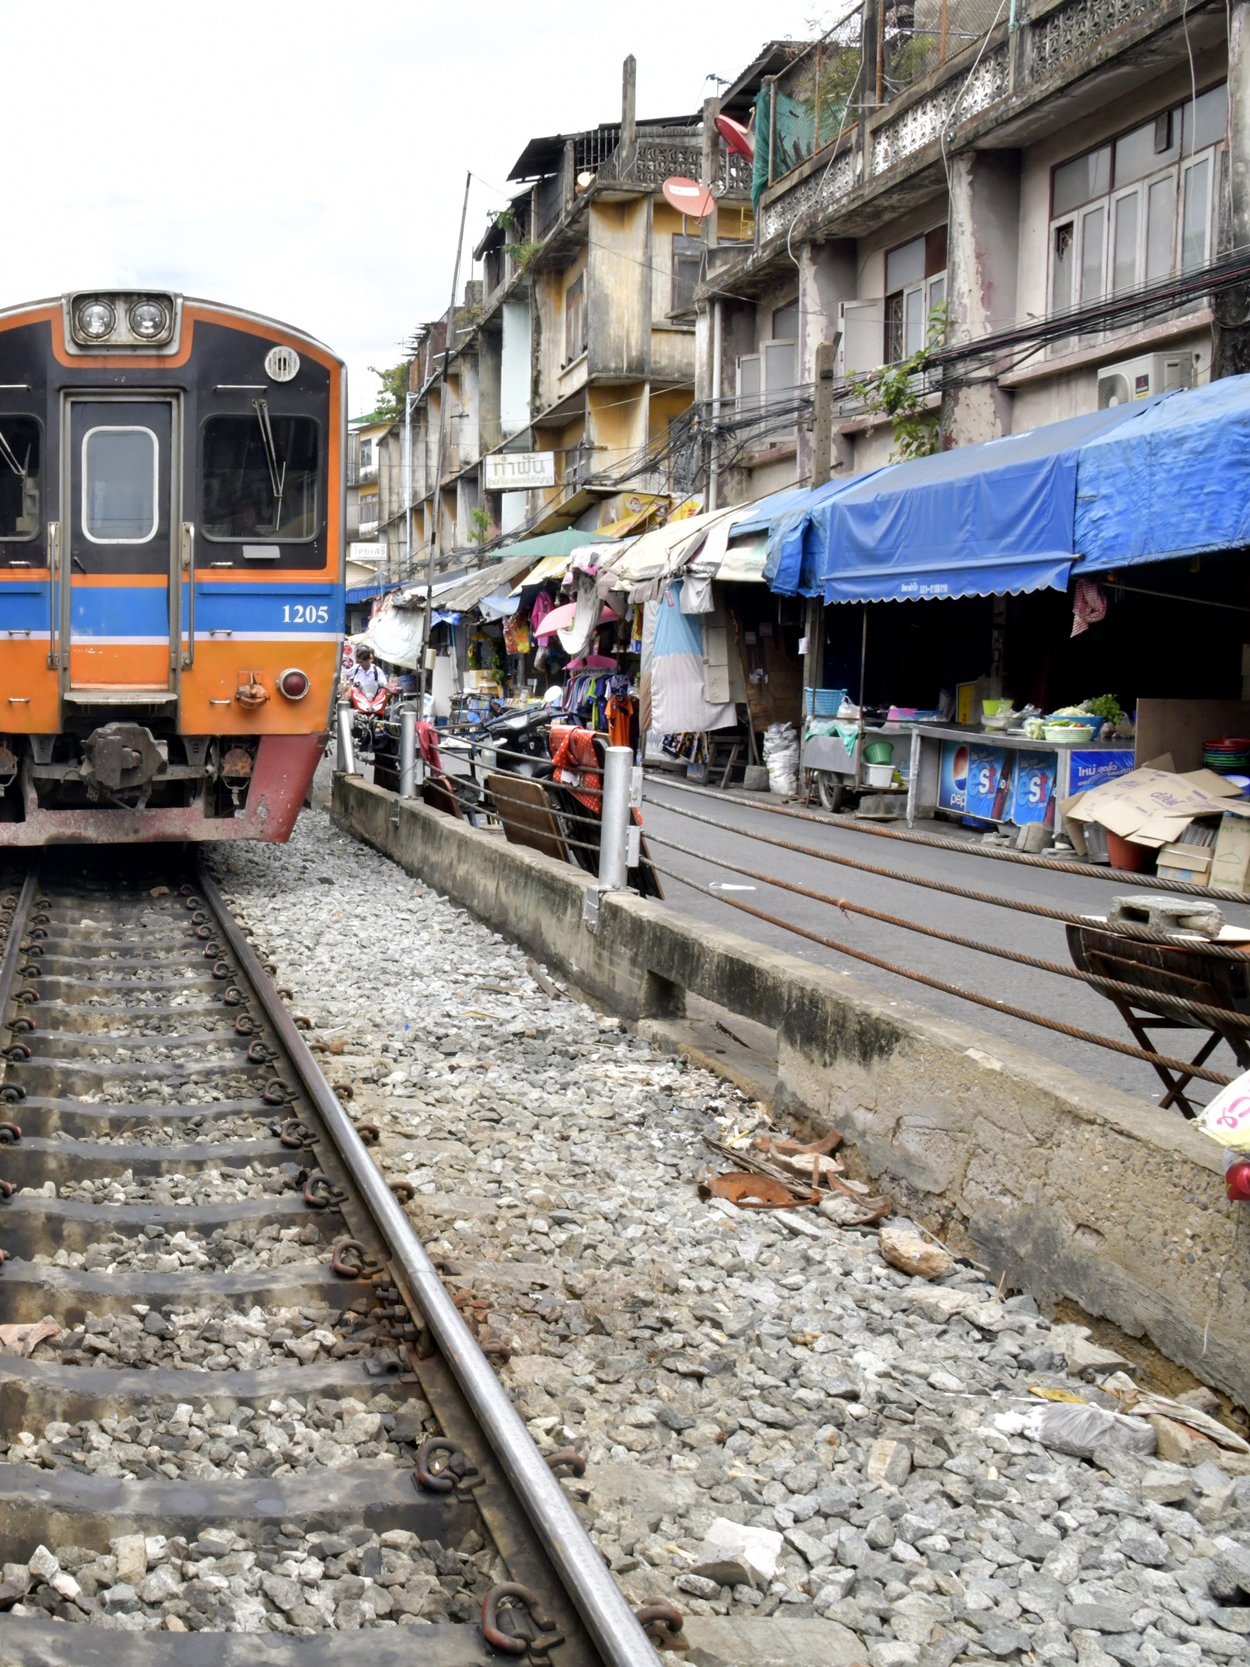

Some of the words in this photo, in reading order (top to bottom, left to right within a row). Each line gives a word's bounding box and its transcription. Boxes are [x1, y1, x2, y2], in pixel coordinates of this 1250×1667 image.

[493, 454, 546, 476] ทำฟัน
[282, 604, 329, 624] 1205
[968, 766, 996, 796] est
[1016, 773, 1048, 806] est
